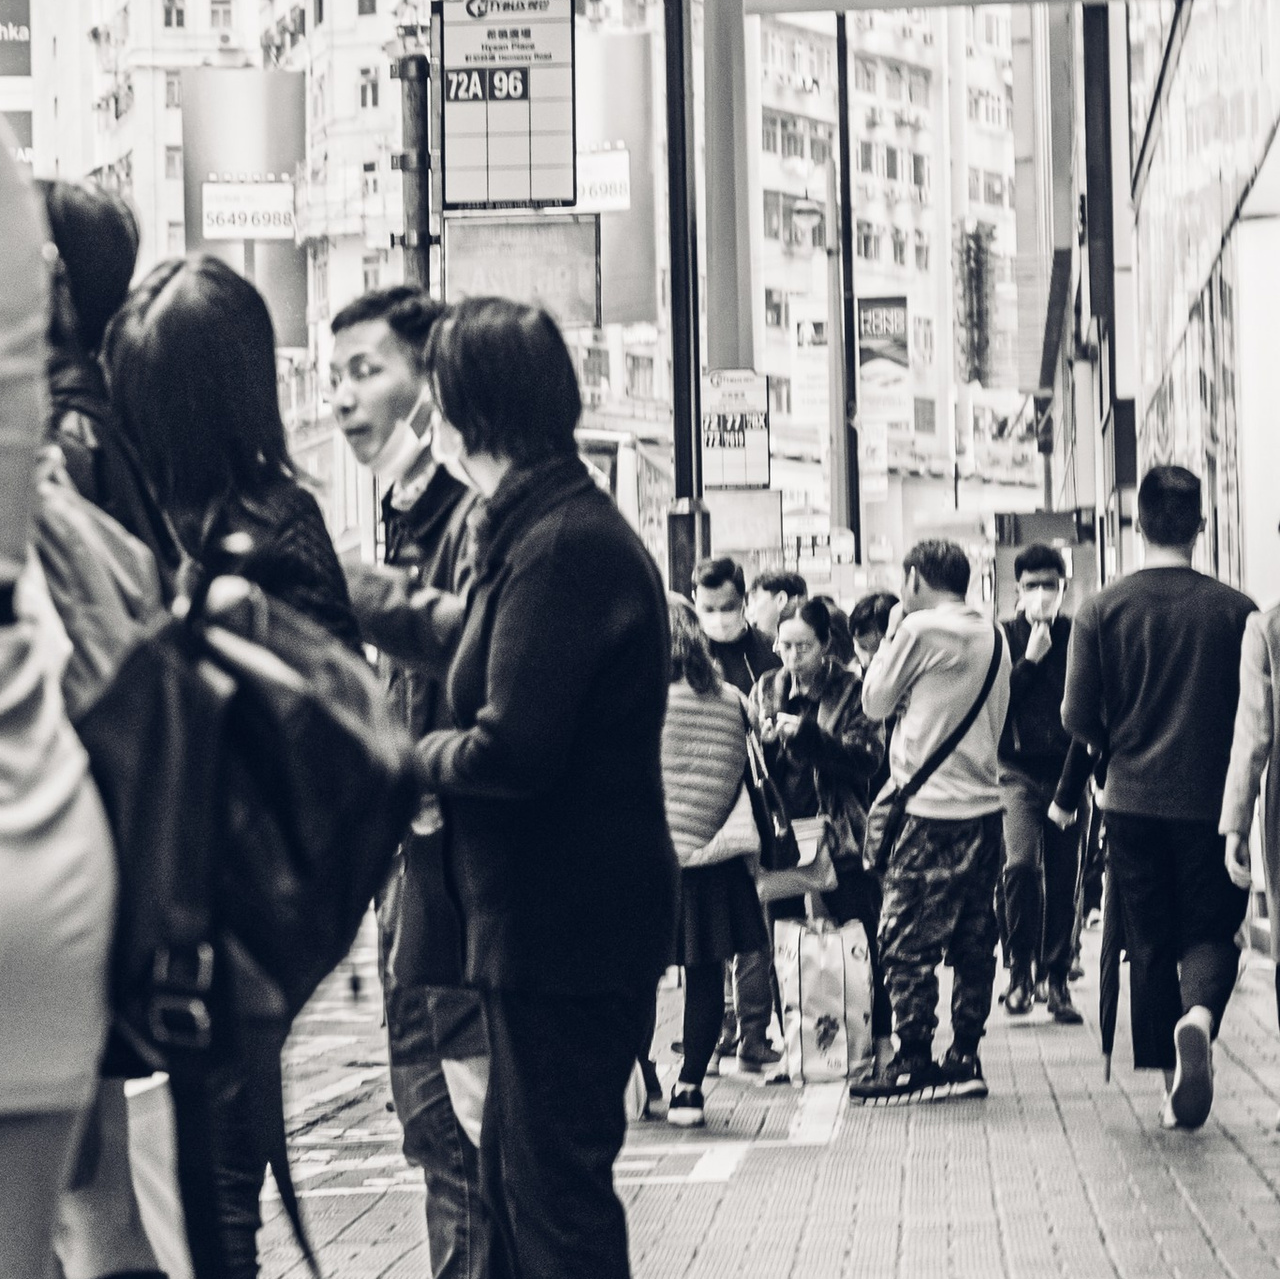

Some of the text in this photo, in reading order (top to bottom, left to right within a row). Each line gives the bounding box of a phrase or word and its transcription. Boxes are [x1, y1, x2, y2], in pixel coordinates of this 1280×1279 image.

[448, 70, 523, 100] 72A 96
[206, 210, 293, 227] 5649 6988
